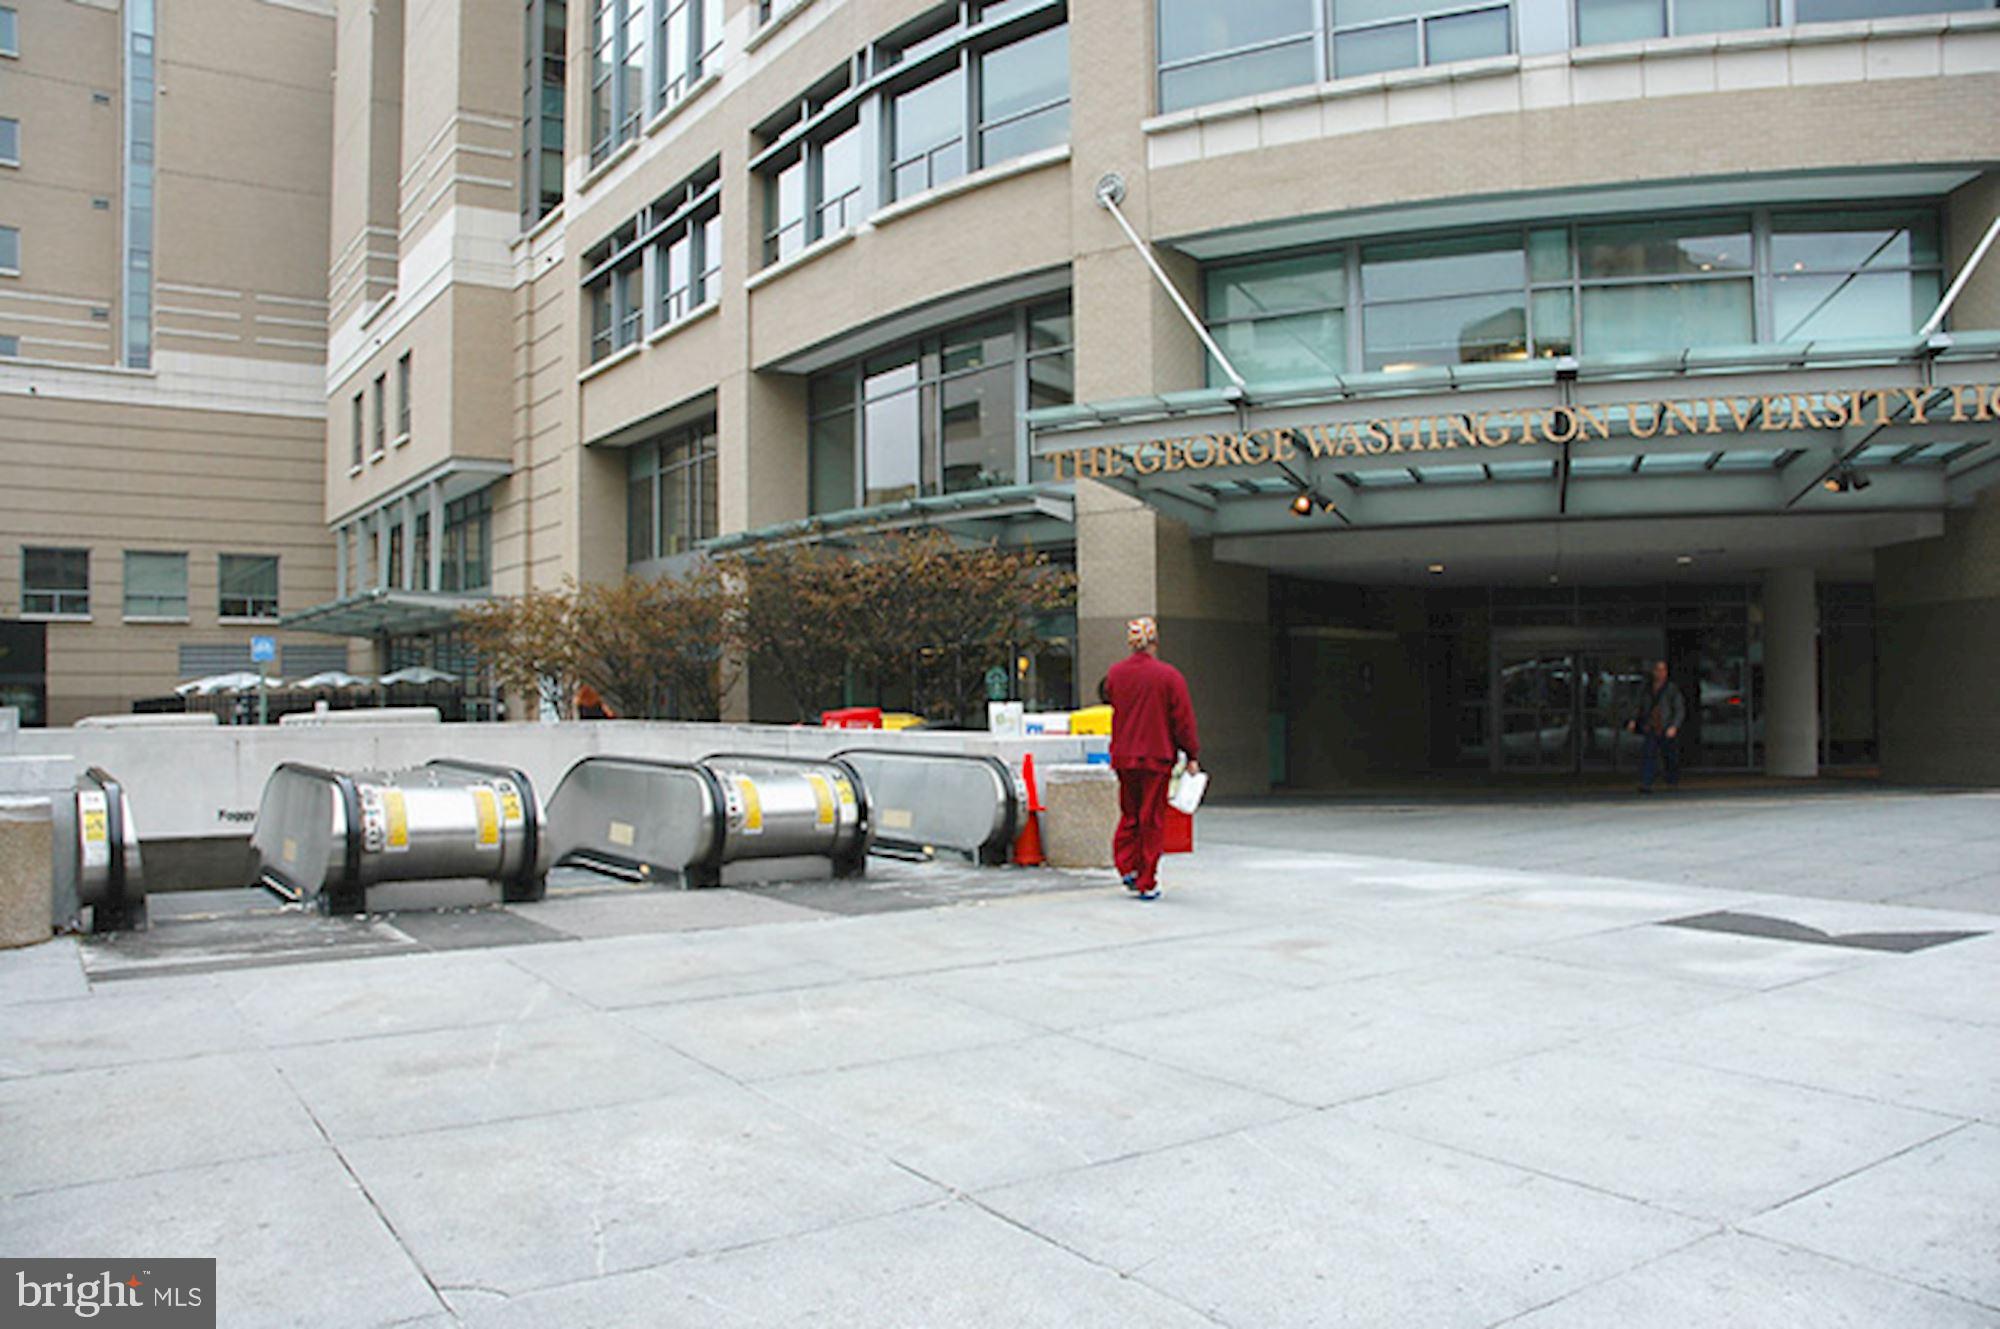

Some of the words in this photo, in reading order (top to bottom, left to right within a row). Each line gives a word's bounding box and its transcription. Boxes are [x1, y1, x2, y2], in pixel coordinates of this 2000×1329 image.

[1045, 444, 1125, 481] THE
[1132, 428, 1297, 475] GEORGE
[1304, 404, 1610, 459] WASHINGTON
[1627, 385, 1932, 438] UNIVERSITY
